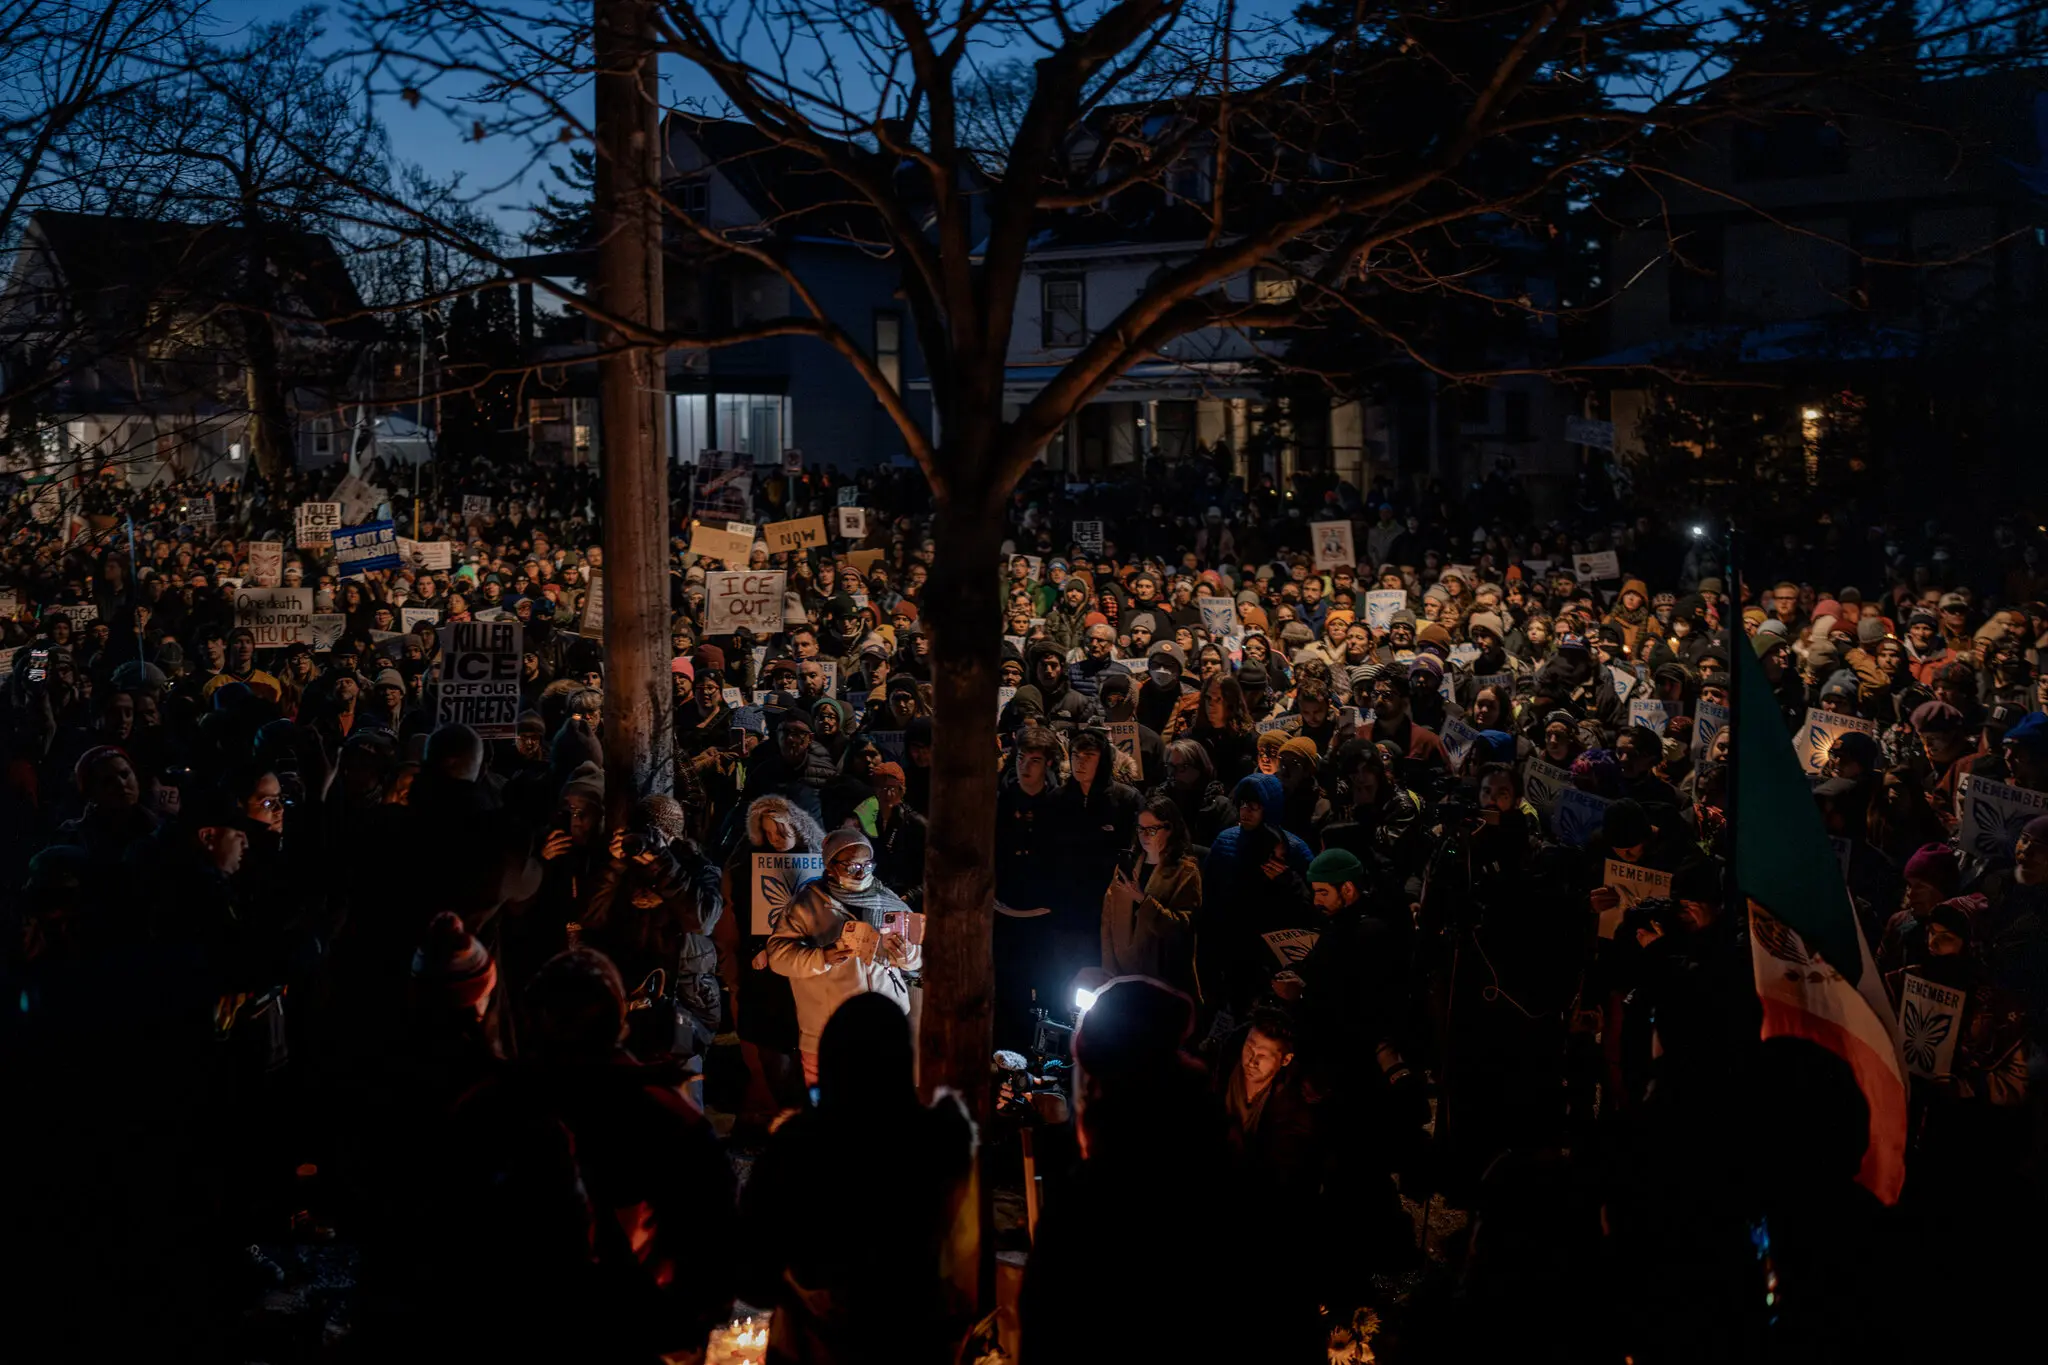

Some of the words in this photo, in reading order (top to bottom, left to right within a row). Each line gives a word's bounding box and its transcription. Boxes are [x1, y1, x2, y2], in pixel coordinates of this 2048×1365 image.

[304, 516, 338, 525] ICE
[335, 535, 353, 551] ICE
[354, 531, 378, 548] OUT
[378, 528, 394, 542] OF
[780, 529, 815, 546] NOW
[719, 576, 775, 597] ICE
[237, 593, 263, 610] One
[266, 593, 303, 610] death
[729, 599, 770, 616] OUT
[240, 614, 252, 626] is
[255, 612, 275, 624] too
[253, 626, 278, 642] TFO
[453, 623, 514, 652] KILLER
[443, 652, 518, 680] ICE
[442, 683, 478, 695] OFF
[481, 683, 517, 695] OUR
[440, 696, 517, 724] STREETS
[1811, 711, 1869, 732] REMEMBER
[1611, 864, 1670, 888] REMEMBE
[1906, 978, 1960, 1009] REMEMBER
